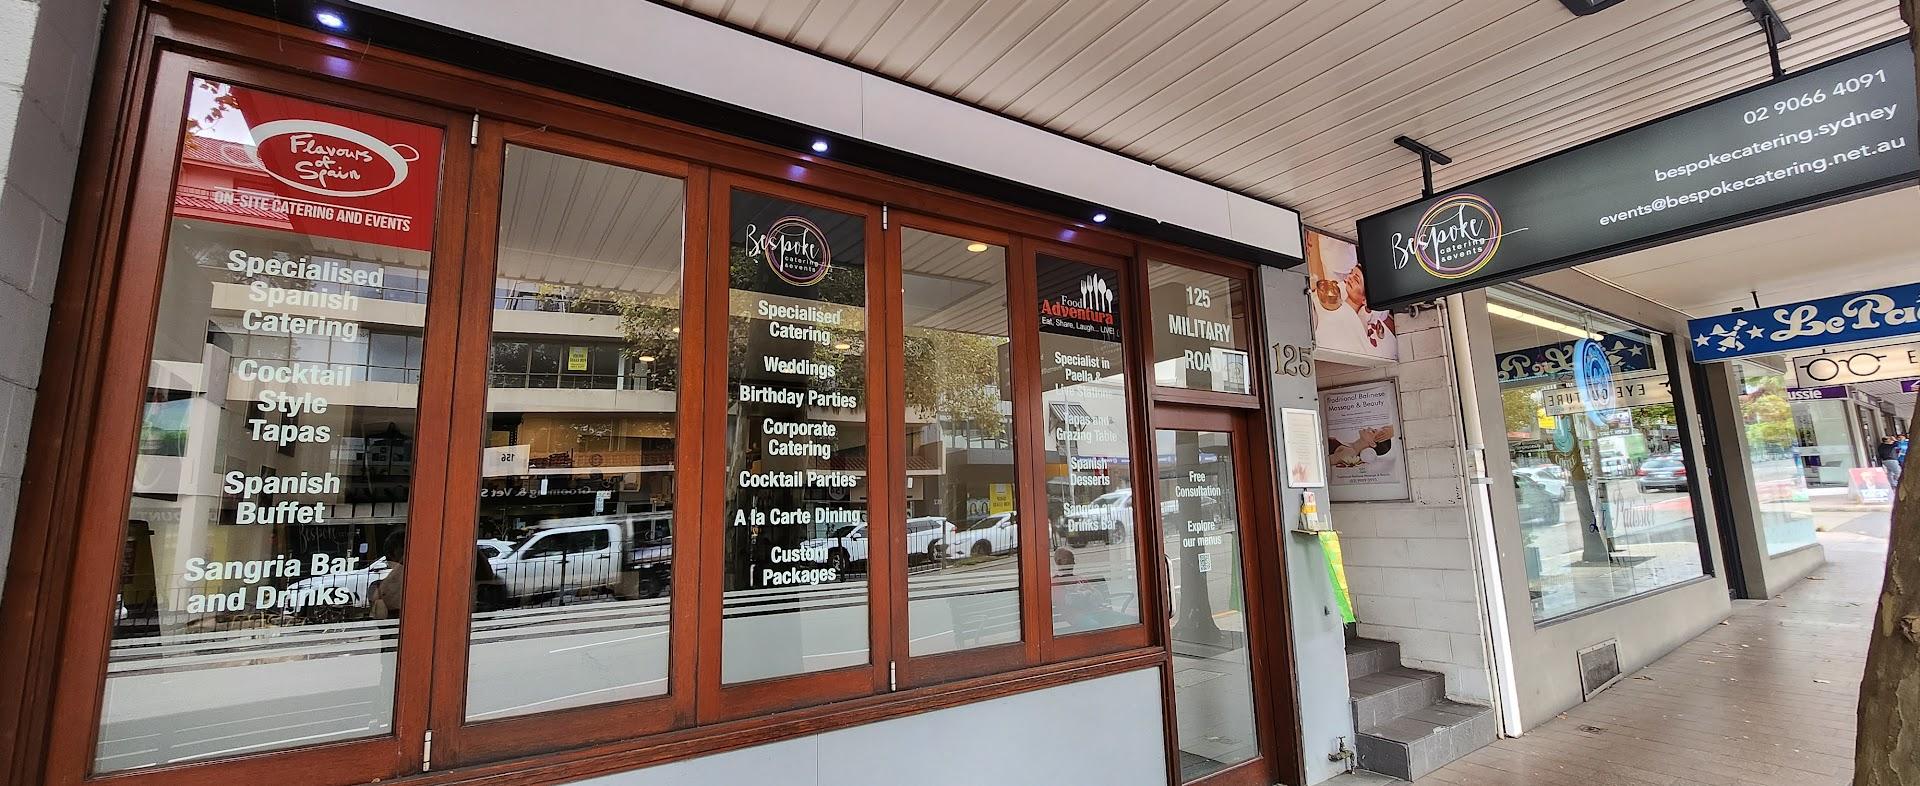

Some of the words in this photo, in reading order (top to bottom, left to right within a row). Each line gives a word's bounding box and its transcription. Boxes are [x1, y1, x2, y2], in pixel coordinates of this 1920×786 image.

[1743, 107, 1769, 125] 02
[1773, 88, 1827, 118] 9066
[1832, 69, 1887, 97] 4091
[290, 134, 373, 162] Flavours
[1654, 103, 1898, 182] bespokecatering.sydney
[295, 160, 361, 188] Spain
[315, 155, 336, 169] of
[1598, 135, 1906, 227] events@bespokecatering.net.au
[214, 190, 269, 212] ON-SITE
[271, 199, 334, 221] CATERING
[336, 209, 363, 225] AND
[365, 214, 411, 233] EVENTS
[745, 223, 822, 272] Bespoke
[1391, 204, 1484, 270] Bespoke
[1439, 237, 1486, 256] catering
[784, 256, 819, 268] catering
[1440, 245, 1484, 263] &events
[226, 249, 385, 287] Specialised
[248, 280, 358, 312] Spanish
[1061, 295, 1082, 308] Food
[1186, 285, 1211, 309] 125
[758, 300, 841, 325] Specialised
[1041, 299, 1113, 325] Adventura
[1769, 304, 1845, 342] Le
[242, 309, 359, 342] Catering
[769, 321, 831, 346] Catering
[1100, 325, 1115, 335] LIVE!
[1168, 314, 1231, 343] MILITARY
[764, 355, 836, 379] Weddings
[1055, 351, 1100, 369] Specialist
[1101, 357, 1110, 370] in
[1272, 342, 1313, 378] 125
[238, 359, 352, 387] Cocktail
[1065, 368, 1093, 383] Paella
[1093, 371, 1102, 382] &
[257, 389, 328, 417] Style
[739, 385, 804, 408] Birthday
[808, 390, 857, 408] Parties
[1787, 388, 1823, 400] ussie
[248, 418, 331, 446] Tapas
[763, 417, 836, 438] Corporate
[1064, 413, 1091, 428] Tapas
[1092, 415, 1110, 426] and
[1056, 427, 1092, 443] Grazing
[1094, 430, 1118, 442] Table
[768, 439, 831, 460] Catering
[1071, 456, 1108, 472] Spanish
[223, 470, 341, 498] Spanish
[739, 470, 803, 488] Cocktail
[807, 471, 857, 488] Parties
[1070, 473, 1110, 487] Desserts
[1189, 471, 1206, 483] Free
[1175, 485, 1221, 499] Consultation
[236, 501, 325, 525] Buffet
[734, 508, 746, 526] A
[750, 509, 765, 525] la
[769, 508, 811, 525] Carte
[815, 507, 860, 524] Dining
[1067, 518, 1099, 533] Drinks
[1101, 518, 1117, 531] Bar
[1187, 520, 1216, 534] Explore
[1183, 538, 1197, 548] our
[1197, 535, 1222, 547] menus
[771, 546, 829, 563] Custom
[183, 554, 301, 584] Sangria
[310, 553, 360, 576] Bar
[763, 566, 837, 586] Packages
[186, 587, 246, 613] and
[256, 584, 350, 611] Drinks
